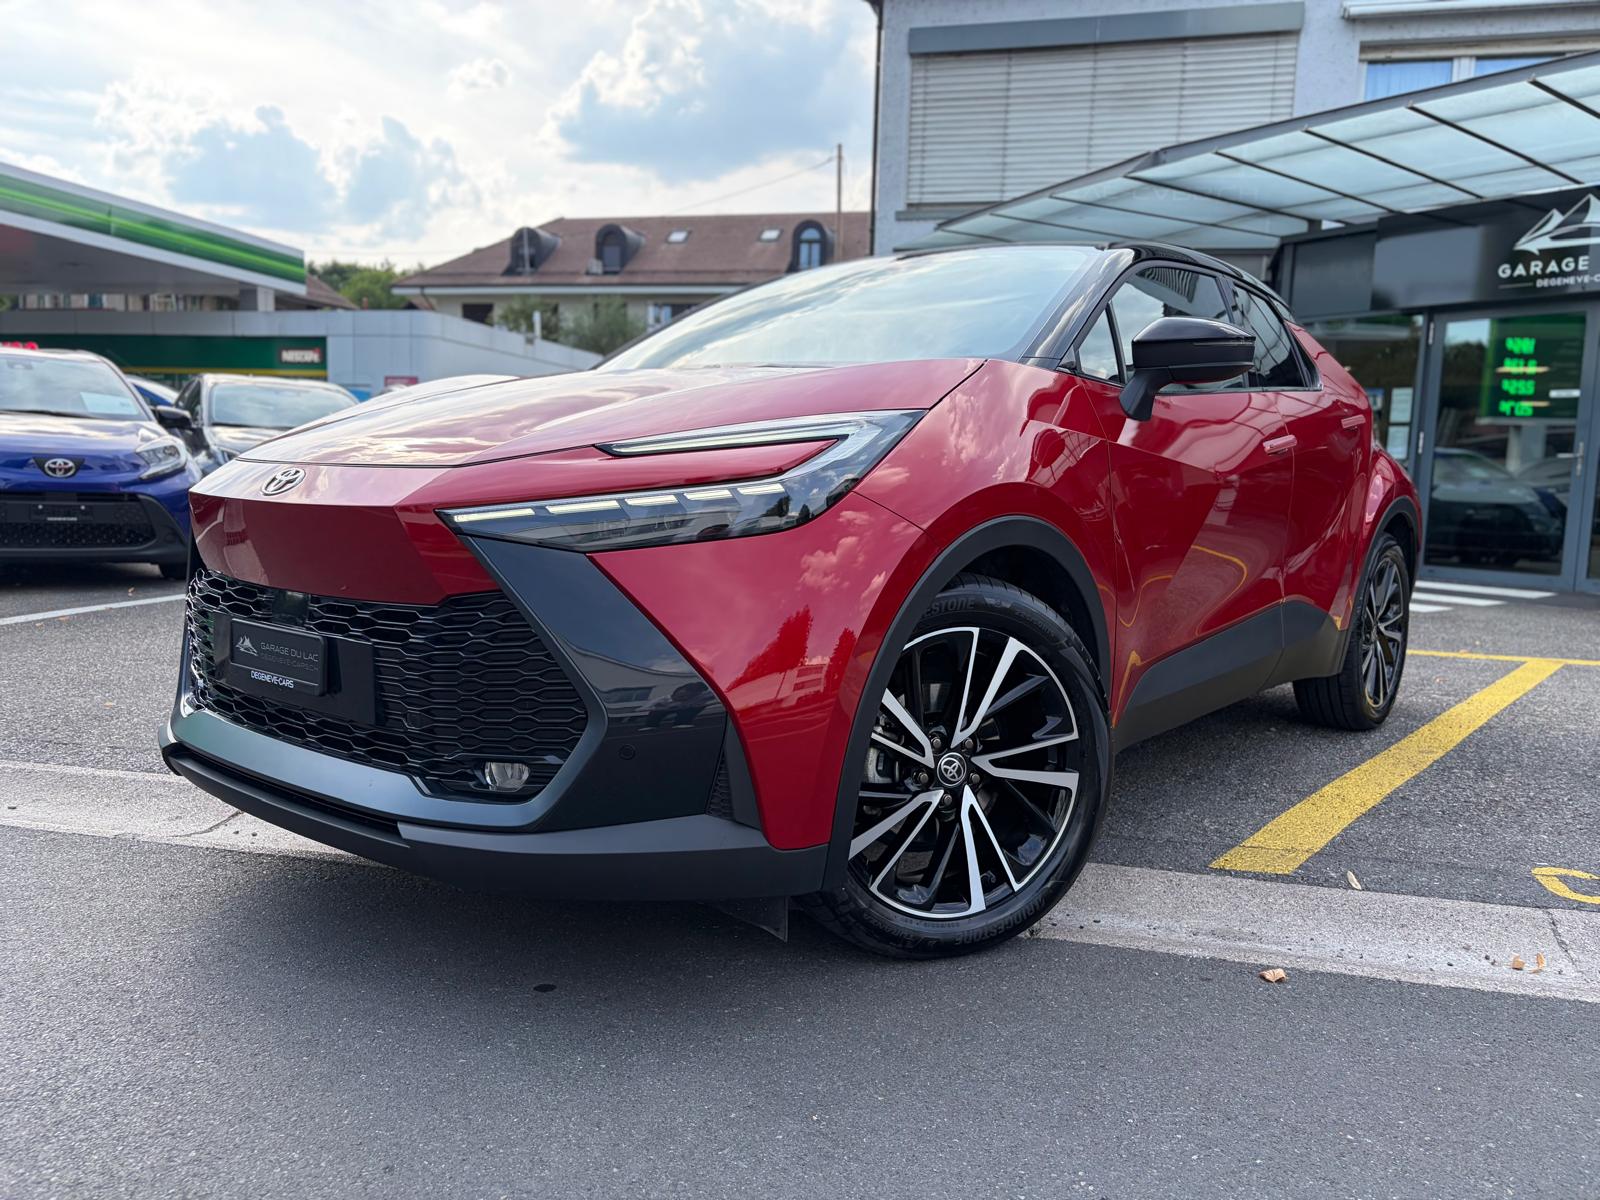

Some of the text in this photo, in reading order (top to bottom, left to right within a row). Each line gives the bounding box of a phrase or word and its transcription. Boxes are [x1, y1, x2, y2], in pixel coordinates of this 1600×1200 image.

[1497, 255, 1590, 279] GARAGE
[260, 642, 319, 662] GARAGE DU LAC
[250, 670, 294, 689] DEGENEVE-CARS
